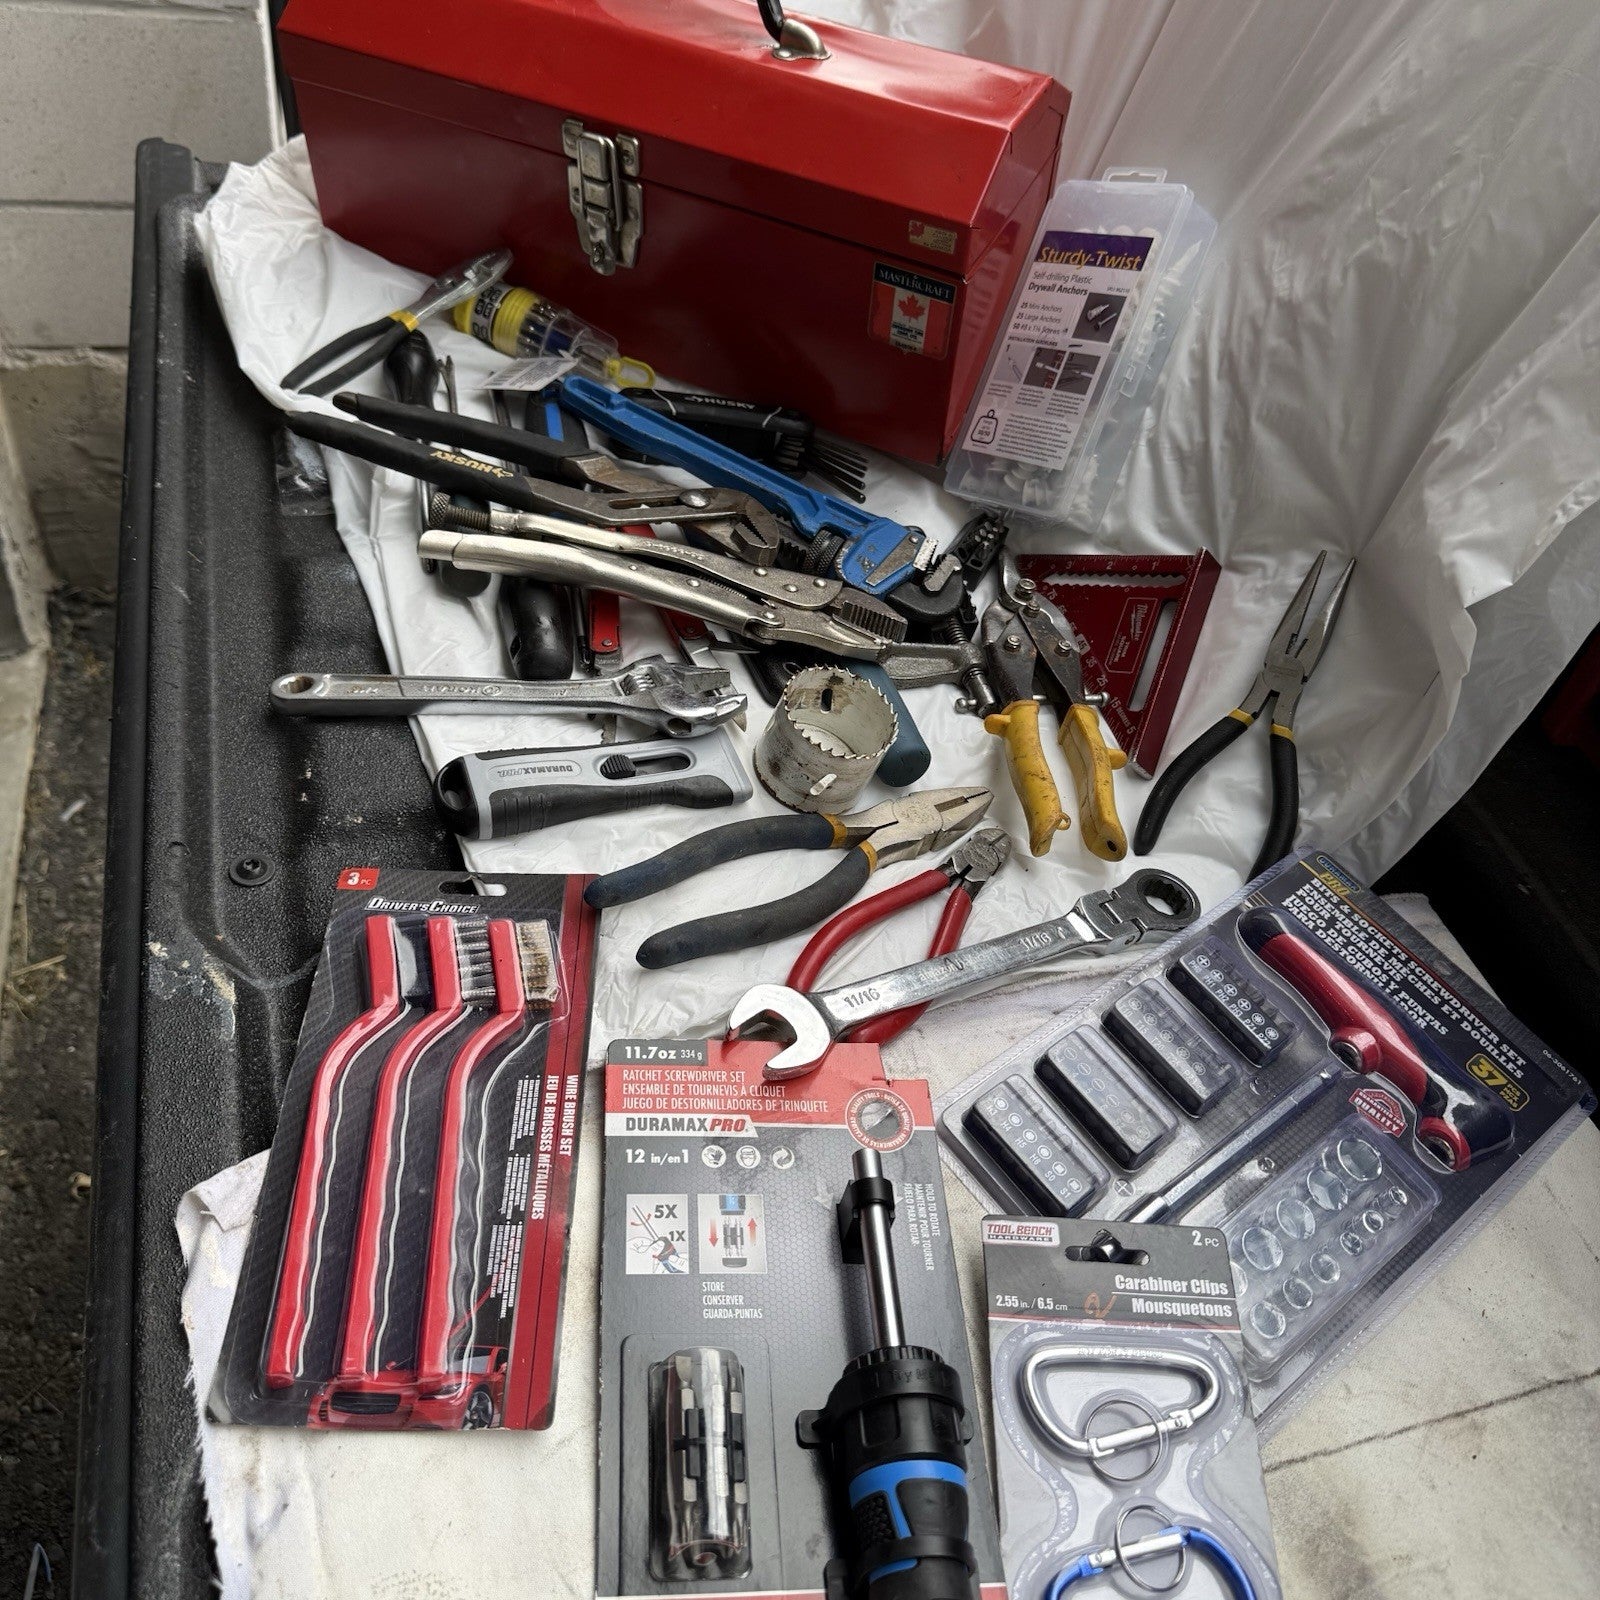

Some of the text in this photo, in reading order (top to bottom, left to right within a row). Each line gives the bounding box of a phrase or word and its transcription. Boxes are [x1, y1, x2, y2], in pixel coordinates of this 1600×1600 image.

[1038, 247, 1141, 270] Sturdy-Twist
[879, 268, 950, 299] MASTERCRAFT
[1033, 271, 1092, 285] Self-drilling Plastic
[1028, 282, 1088, 296] Drywall Anchors
[1041, 304, 1062, 313] Anchors
[1024, 313, 1038, 321] Large
[1040, 314, 1061, 324] Anchors
[703, 396, 756, 410] HUSKY
[429, 449, 493, 473] HUSKY
[1066, 560, 1074, 570] 3
[1106, 561, 1113, 570] 2
[1047, 589, 1058, 601] 75
[1134, 603, 1149, 641] Milwaukee
[1086, 656, 1098, 668] 35
[1096, 674, 1108, 687] 25
[1110, 696, 1121, 709] 15
[1127, 724, 1136, 734] 5
[346, 871, 360, 887] 3
[1282, 897, 1315, 929] PARA
[1296, 888, 1404, 982] POUR TOURNEVIS
[1287, 894, 1449, 1036] JUEGO DE CUBOS Y PUNTAS
[1311, 878, 1527, 1067] BITS & SOCKETS SCREWDRIVER SET
[1302, 883, 1369, 941] ENSEMBLE
[1369, 940, 1389, 958] DE
[1441, 1001, 1460, 1022] ET
[1460, 1020, 1524, 1079] DOUILLES
[844, 987, 882, 1009] 11/16
[1200, 973, 1216, 988] PH1
[1213, 987, 1230, 1003] PH2
[1227, 1002, 1244, 1018] PH3
[1242, 1017, 1257, 1032] PZ1
[1256, 1031, 1271, 1046] PZ2
[1133, 1019, 1150, 1034] T15
[1149, 1036, 1165, 1051] T20
[625, 1047, 702, 1061] 11.7oz 334 g
[623, 1069, 746, 1082] RATCHET SCREWDRIVER SET
[1471, 1058, 1508, 1086] 37
[623, 1082, 786, 1098] ENSEMBLE DE TOURNEVIS À CLIQUET
[622, 1097, 829, 1113] JUEGO DE DESTORNILLADORES DE TRINQUETE
[559, 1074, 579, 1156] WIRE BRUSH SET
[1354, 1096, 1399, 1131] QUALITY
[531, 1075, 559, 1220] JEU DE BROSSES MÉTALLIQUES
[984, 1104, 998, 1116] H3
[999, 1120, 1012, 1132] H4
[1014, 1136, 1027, 1149] H5
[1028, 1153, 1042, 1165] H6
[1058, 1186, 1072, 1199] S1
[626, 1150, 689, 1166] 12 in/en 1
[925, 1183, 935, 1201] HOLD
[654, 1205, 678, 1218] 5X
[906, 1205, 916, 1221] PARA
[914, 1183, 933, 1270] MAINTENIR POUR TOURNER
[929, 1213, 940, 1237] ROTATE
[988, 1224, 1054, 1237] TOOL BENCH
[668, 1230, 685, 1242] 1X
[988, 1234, 1052, 1242] HARDWARE
[1192, 1230, 1219, 1247] 2 PC
[702, 1282, 725, 1292] STORE
[1115, 1275, 1229, 1296] Carabiner Clips
[703, 1295, 744, 1306] CONSERVER
[996, 1295, 1019, 1308] 2.55
[1020, 1299, 1030, 1308] in.
[1037, 1297, 1054, 1310] 6.5
[1132, 1298, 1232, 1318] Mousquetons
[703, 1308, 763, 1319] GUARDA-PUNTAS
